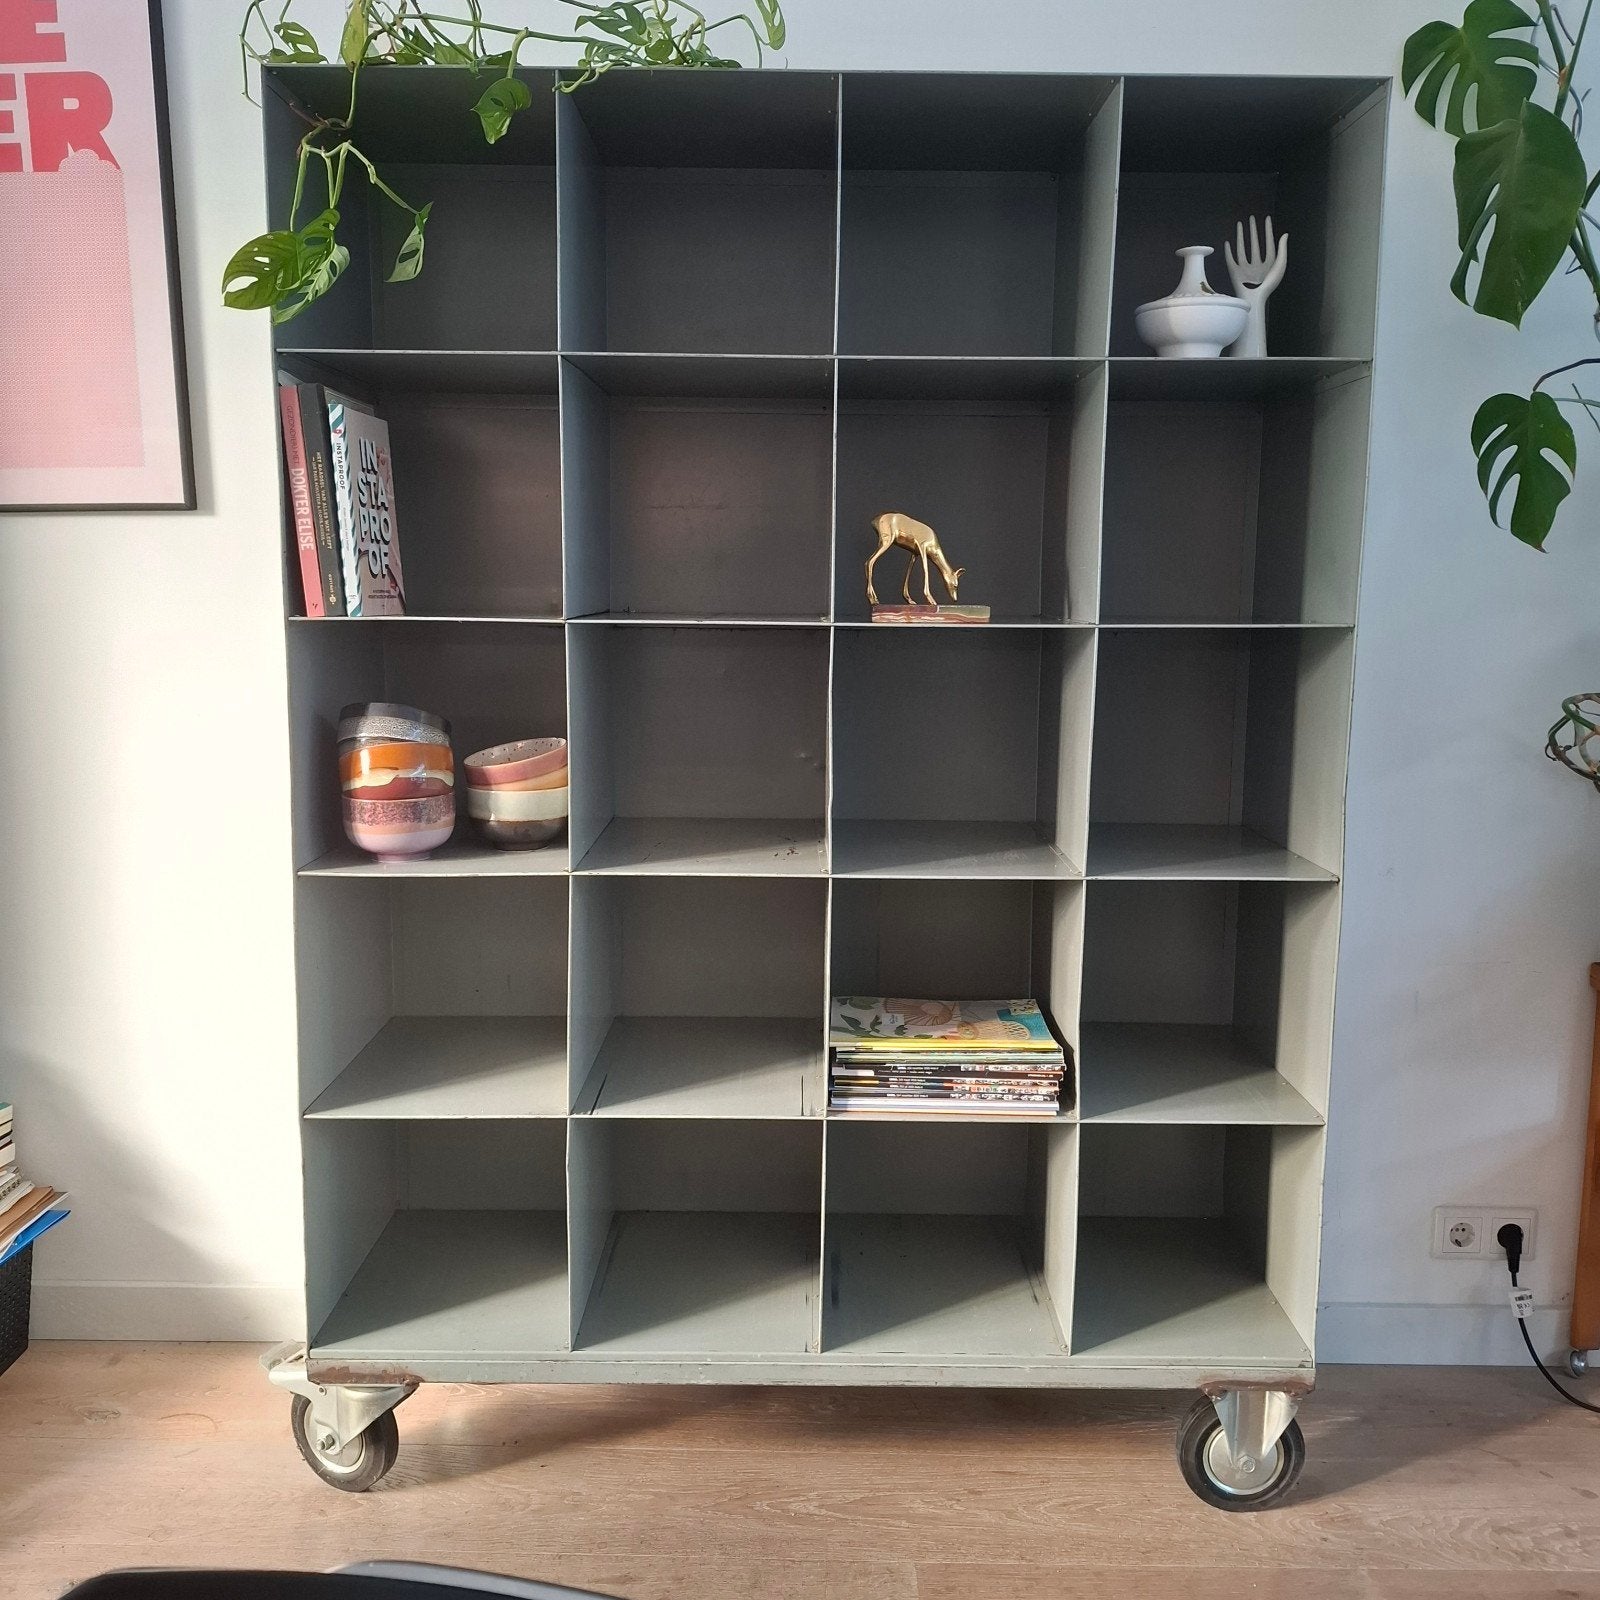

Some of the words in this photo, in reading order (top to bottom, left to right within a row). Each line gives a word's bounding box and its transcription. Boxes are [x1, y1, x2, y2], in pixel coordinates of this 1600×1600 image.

[336, 443, 346, 490] INSTAPROOF
[359, 437, 378, 475] IN
[290, 468, 310, 515] DOKTER
[357, 471, 389, 511] STA
[297, 518, 315, 551] ELISE
[359, 508, 391, 545] PRO
[368, 544, 388, 579] OF
